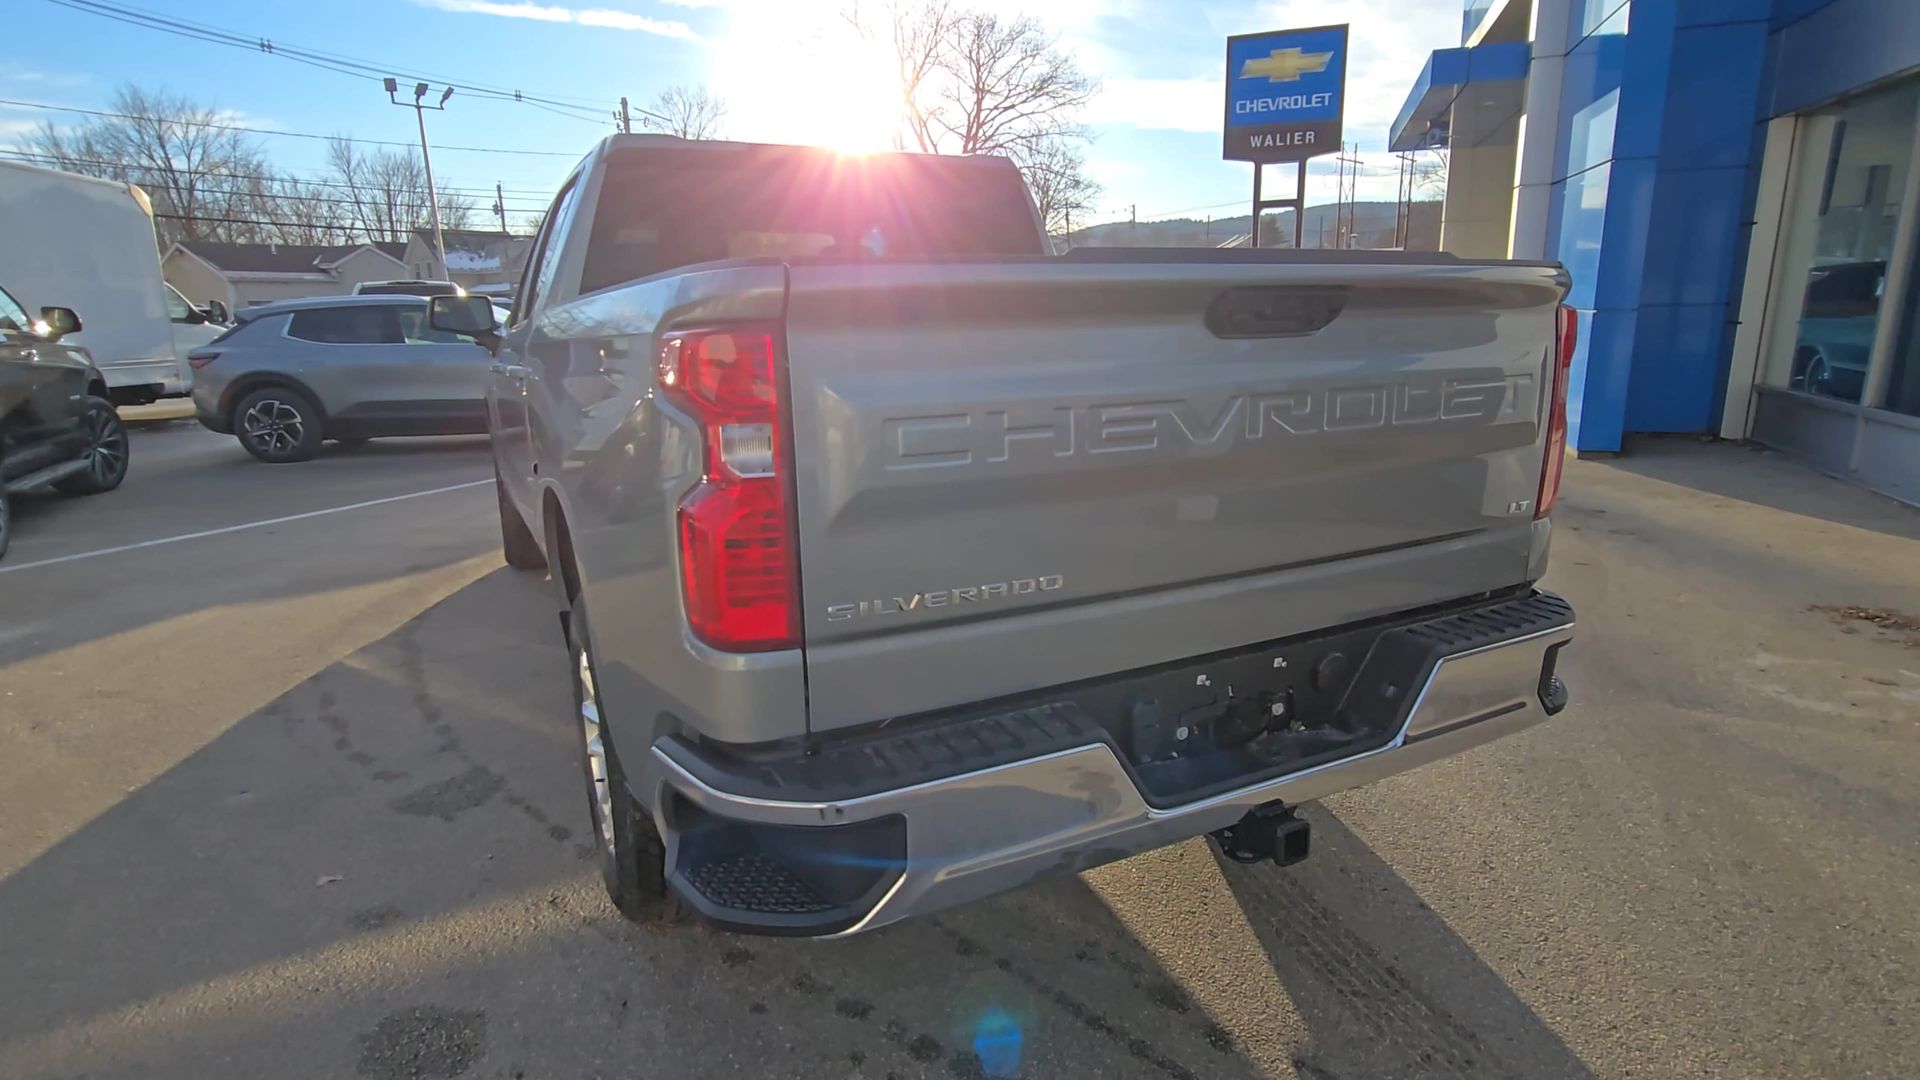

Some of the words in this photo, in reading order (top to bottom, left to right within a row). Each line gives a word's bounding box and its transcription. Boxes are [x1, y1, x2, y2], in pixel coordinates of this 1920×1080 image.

[1235, 92, 1333, 114] CHEVROLET
[1250, 131, 1316, 148] WALIER
[883, 373, 1534, 470] CHEVROLET
[827, 574, 1064, 622] SILVERADO
